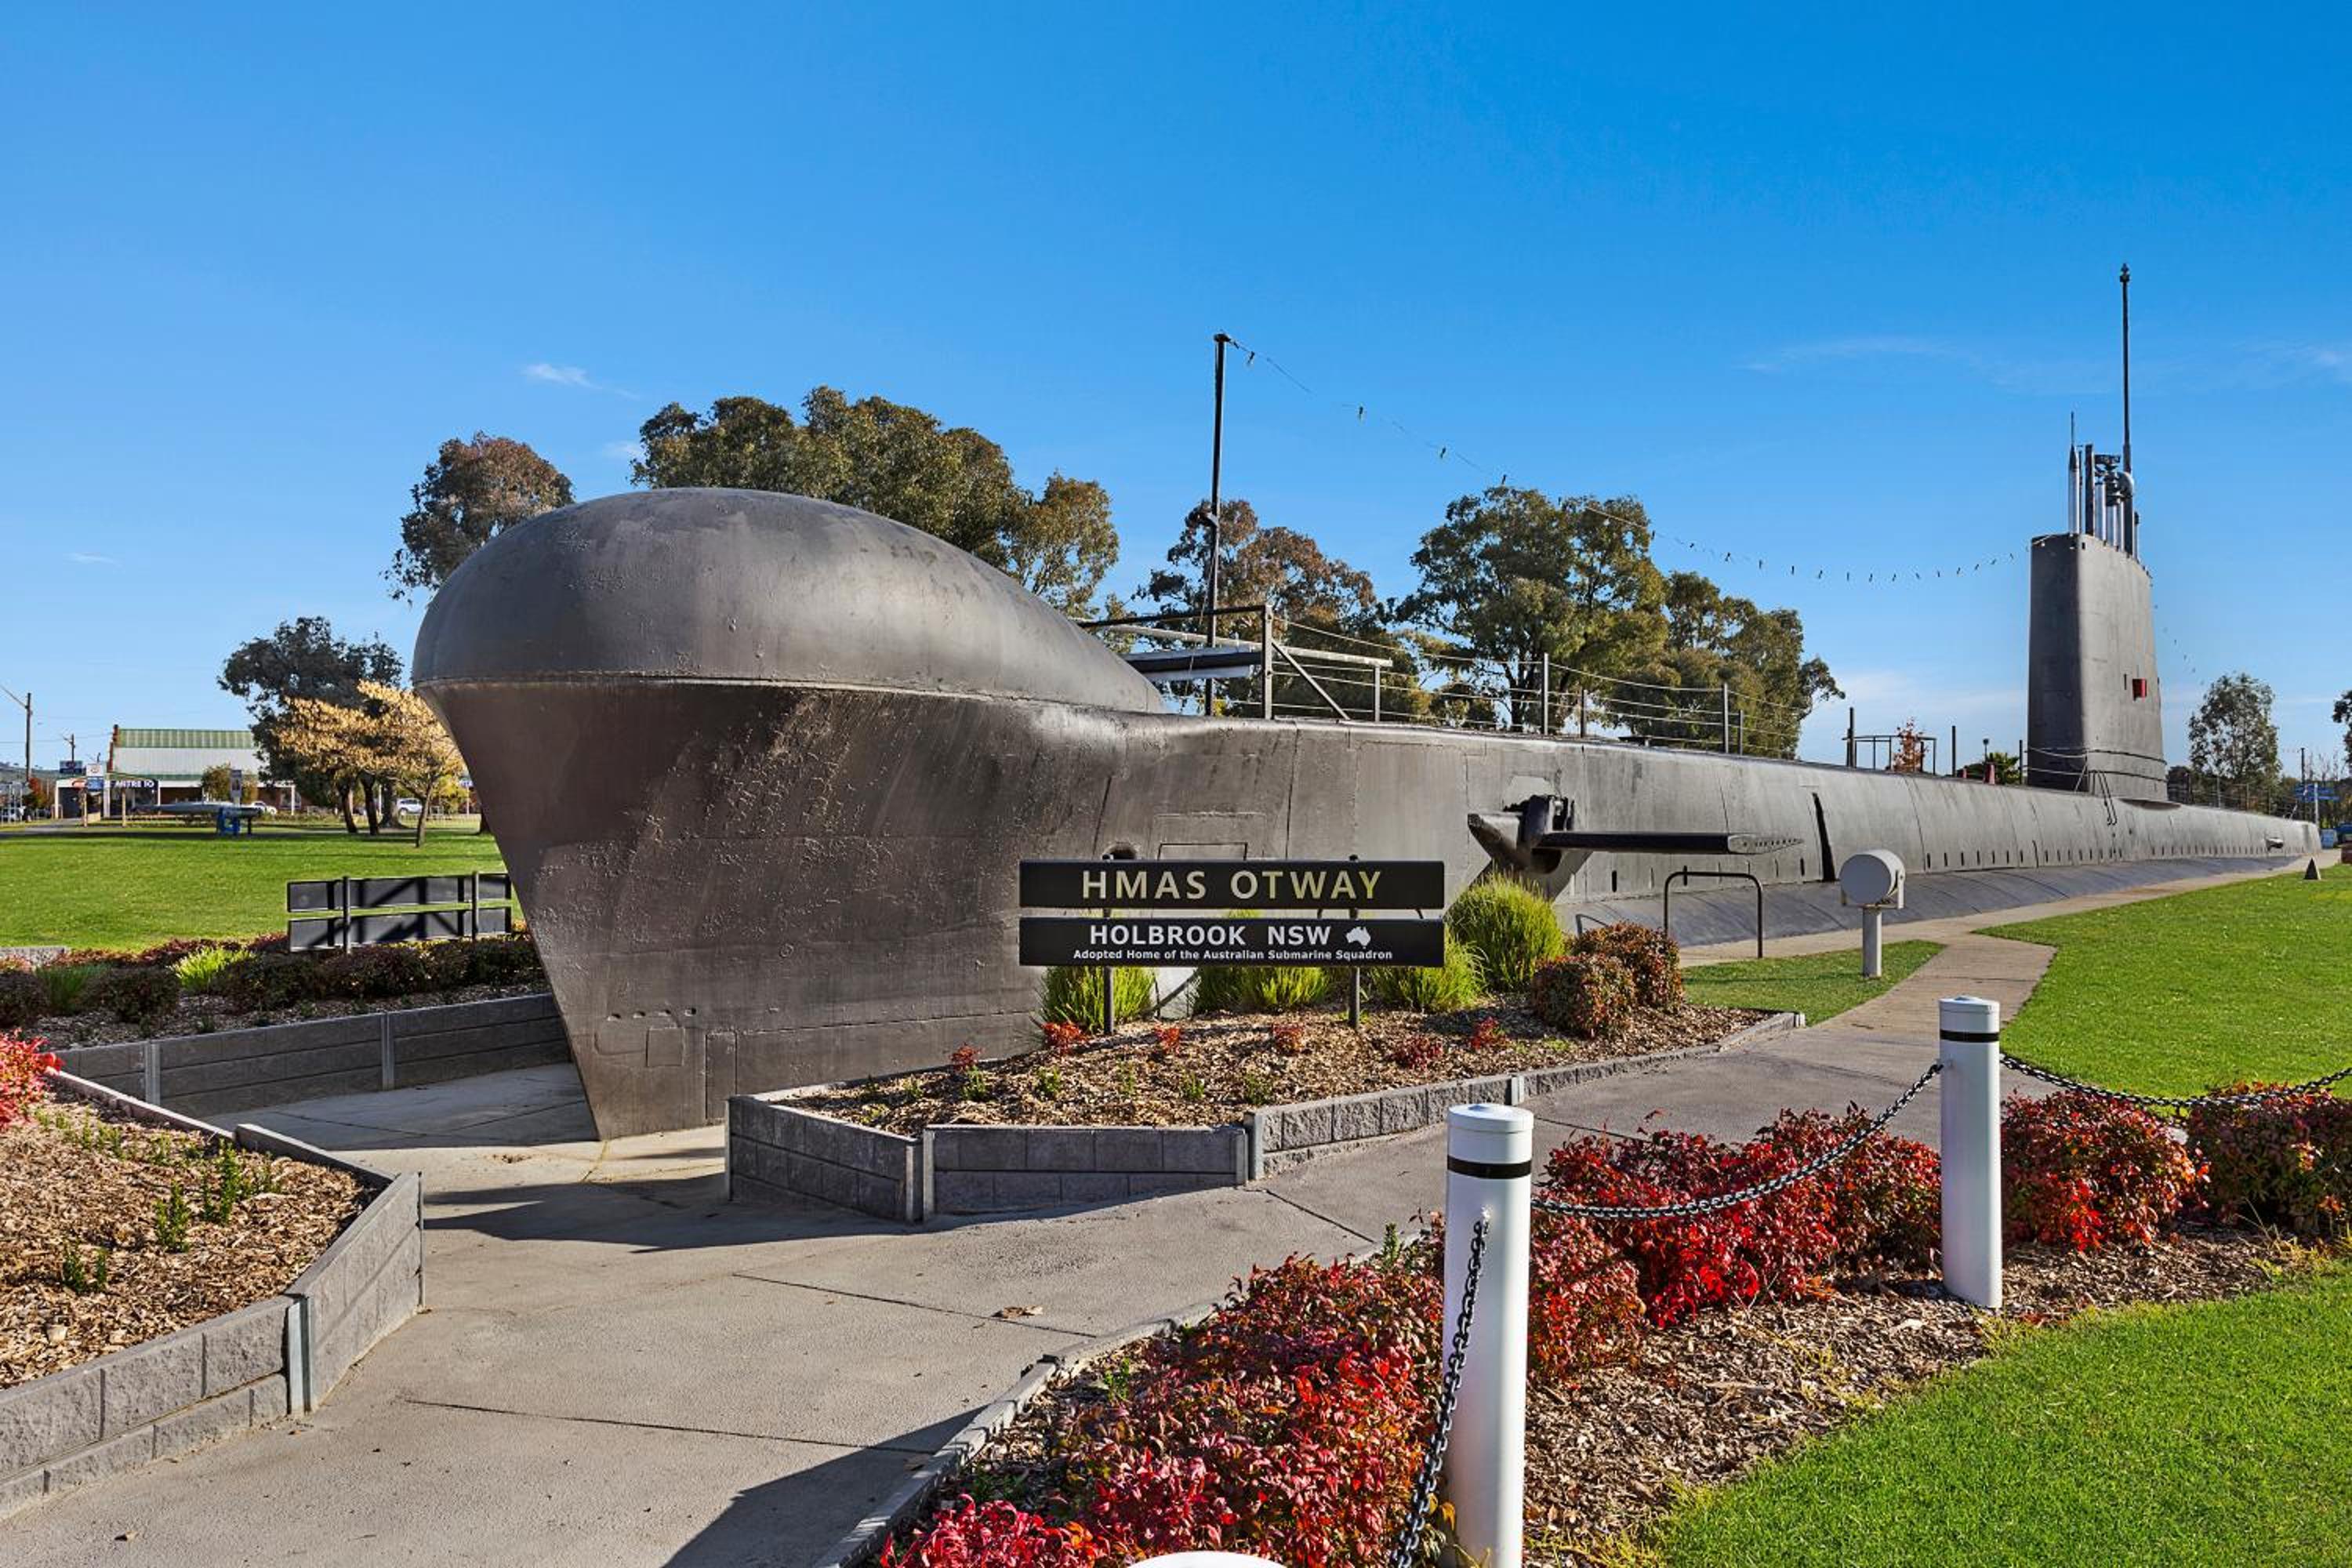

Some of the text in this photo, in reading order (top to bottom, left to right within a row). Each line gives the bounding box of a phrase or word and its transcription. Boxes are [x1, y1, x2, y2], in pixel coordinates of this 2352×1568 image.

[1083, 870, 1381, 899] HMAS OTWAY
[1091, 925, 1331, 946] HOLBROOK NSW
[1073, 949, 1392, 961] Adopted Home of the Australian Submarine Squadron
